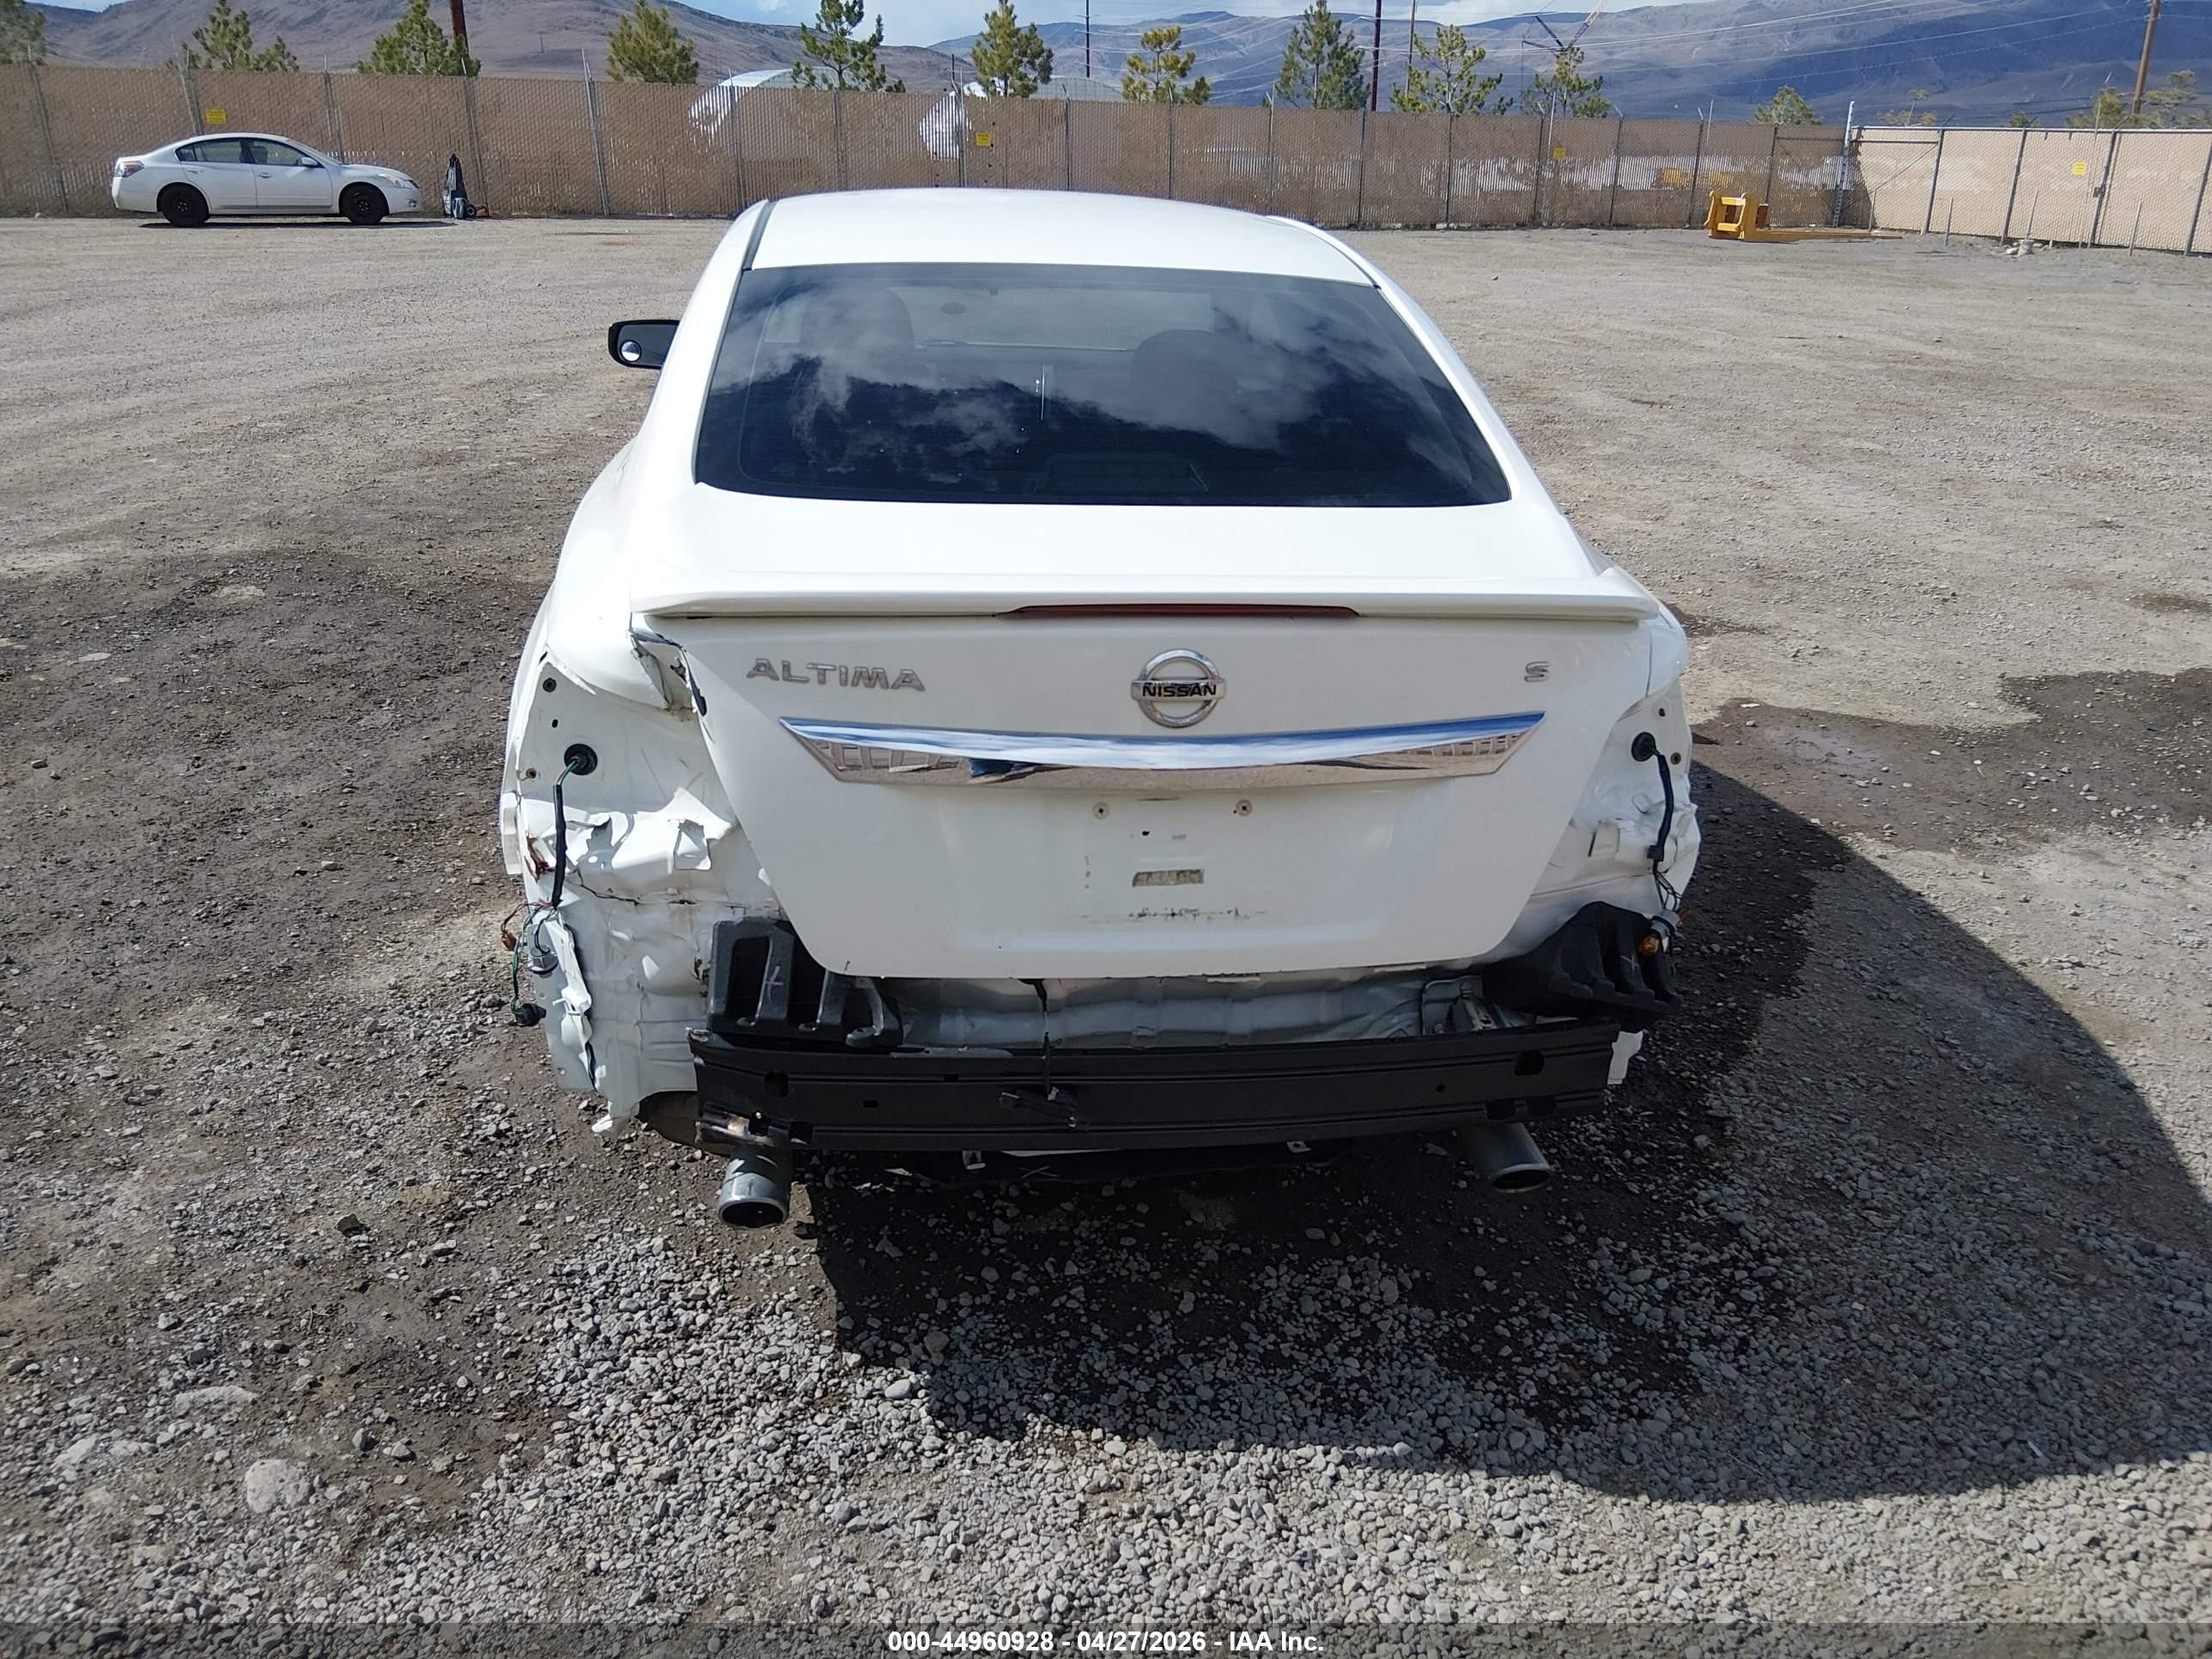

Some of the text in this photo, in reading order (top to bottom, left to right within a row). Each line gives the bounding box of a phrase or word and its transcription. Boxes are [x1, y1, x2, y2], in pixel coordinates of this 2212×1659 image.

[746, 658, 926, 692] ALTIMA
[1524, 660, 1550, 683] S
[1142, 682, 1217, 697] NISSAN
